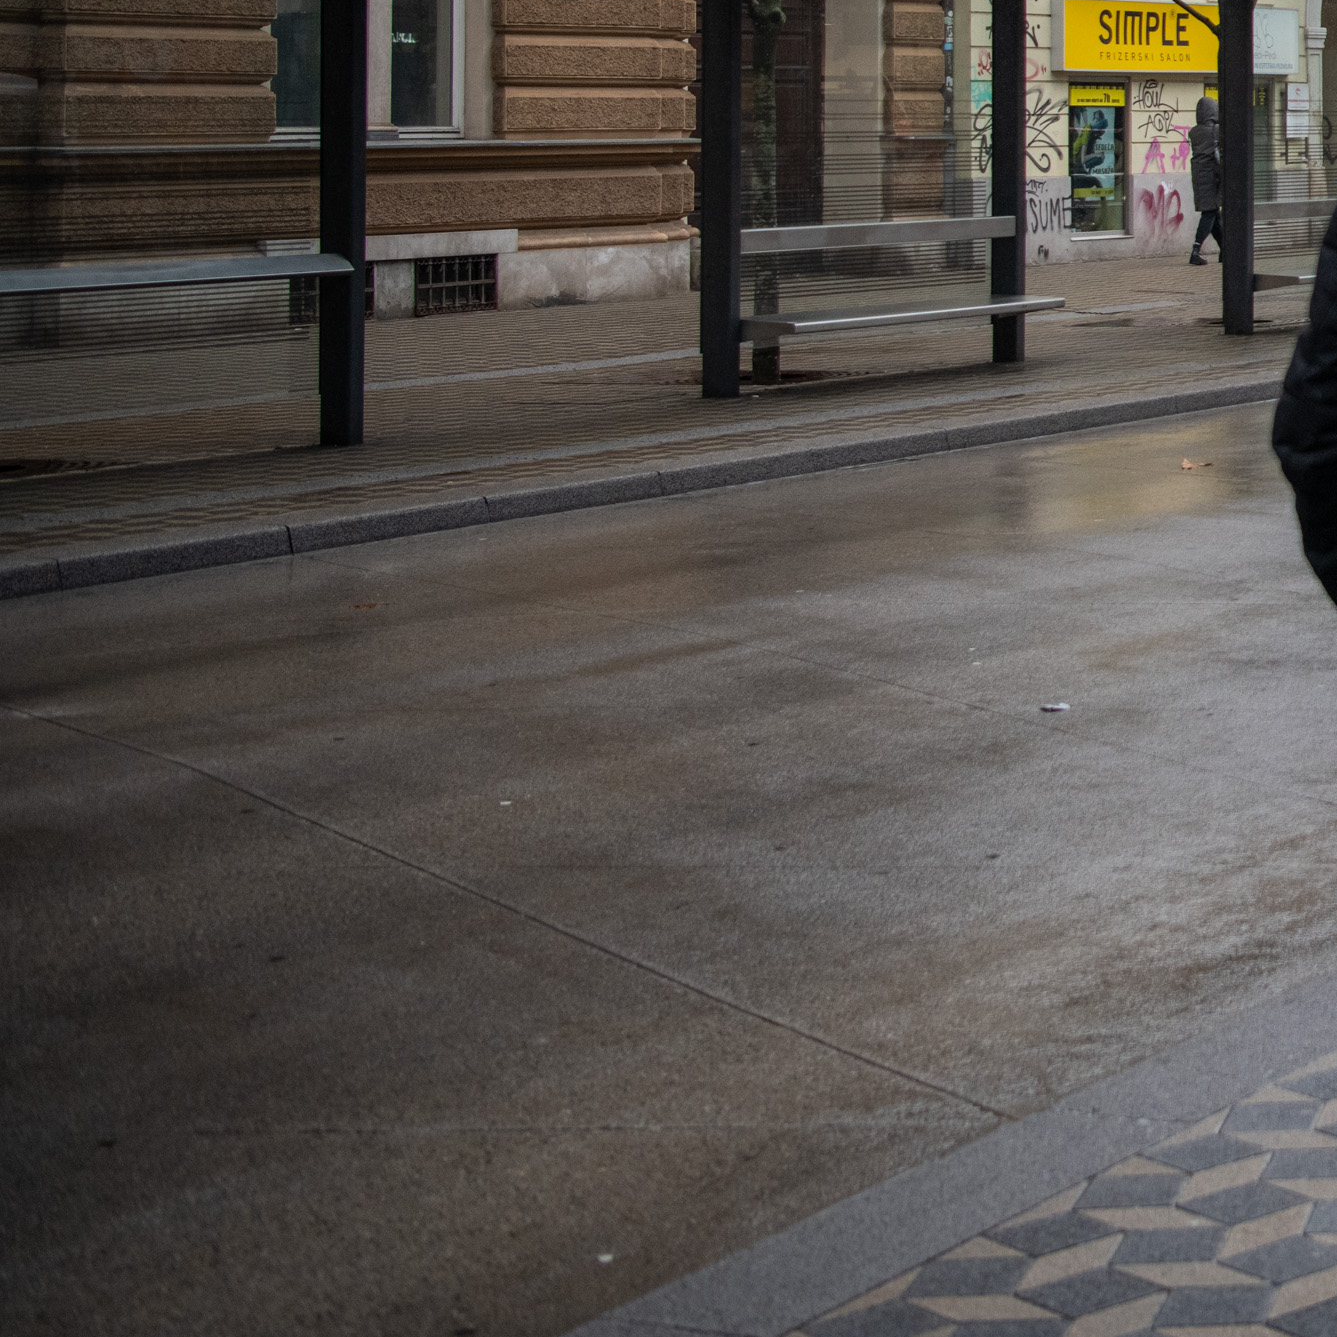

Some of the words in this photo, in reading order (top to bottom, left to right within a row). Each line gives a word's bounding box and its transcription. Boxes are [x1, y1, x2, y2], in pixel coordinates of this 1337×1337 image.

[1099, 9, 1190, 47] SIMPLE
[1100, 51, 1155, 61] FRIZERSKI
[1160, 52, 1191, 62] SALON
